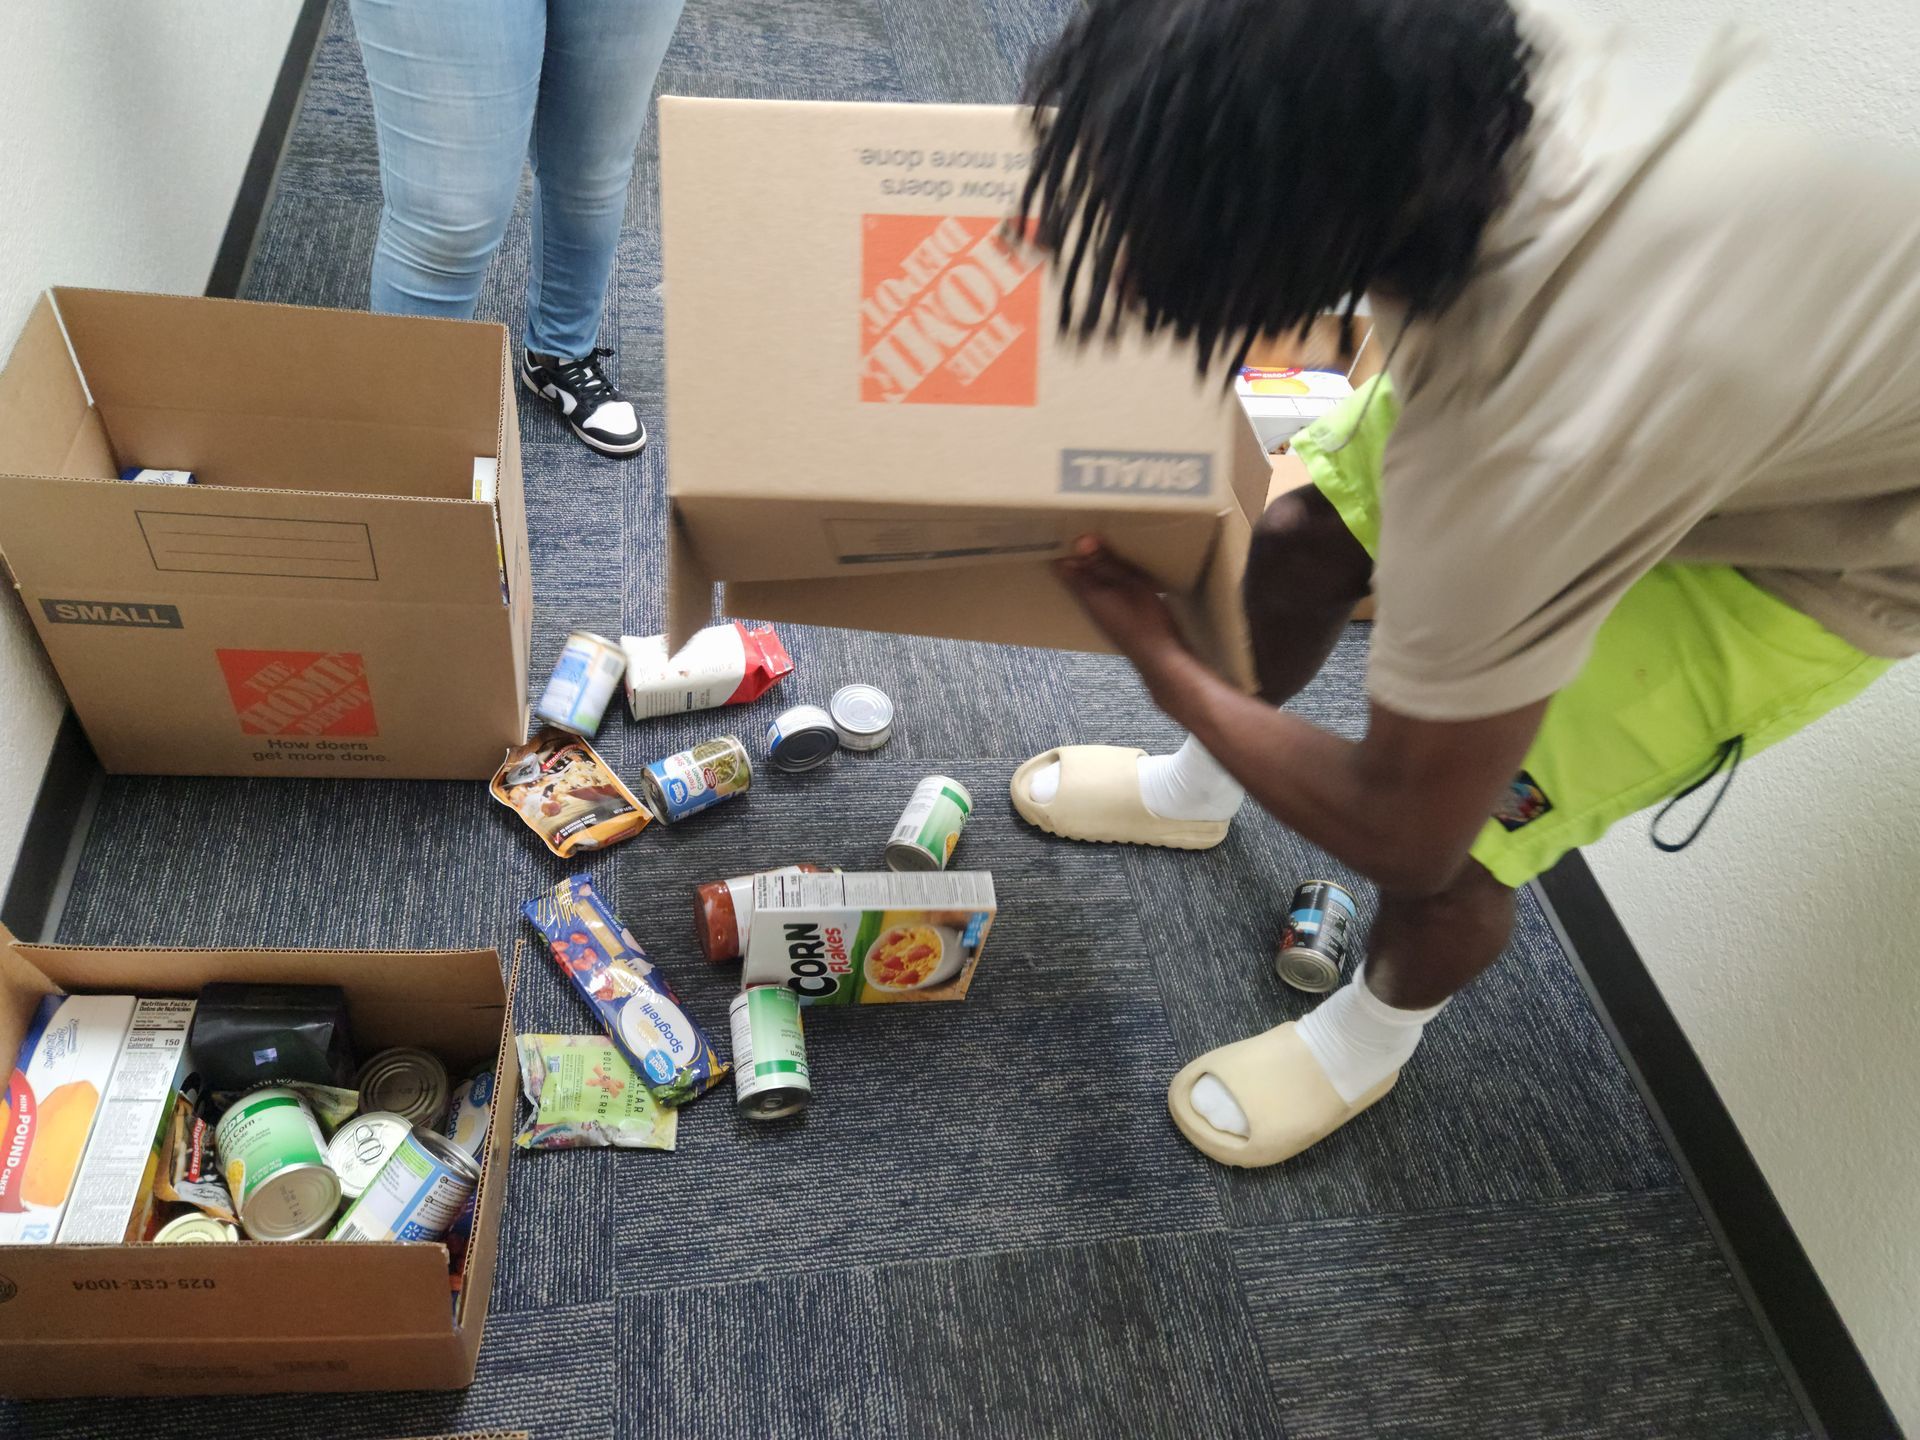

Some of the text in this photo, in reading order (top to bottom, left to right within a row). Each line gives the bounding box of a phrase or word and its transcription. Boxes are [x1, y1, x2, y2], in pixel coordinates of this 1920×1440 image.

[931, 150, 998, 169] more
[880, 178, 1017, 203] How doers
[861, 216, 973, 336] DEPOT
[861, 221, 1048, 402] HOME
[944, 311, 1026, 386] THE
[1071, 456, 1203, 491] SMALL
[55, 603, 171, 625] SMALL
[241, 660, 296, 693] THE
[239, 653, 367, 736] HOME
[297, 687, 370, 736] DEPOT
[252, 752, 283, 762] get
[288, 752, 336, 762] more
[267, 738, 369, 751] How doers
[783, 923, 838, 997] CORN
[825, 927, 852, 974] Flakes
[164, 1038, 180, 1046] 150
[640, 1002, 684, 1054] Spaghetti
[603, 1051, 612, 1071] BOLD
[18, 1094, 28, 1113] MINI
[7, 1114, 32, 1168] POUND
[71, 1278, 217, 1291] 025-CSE-1004
